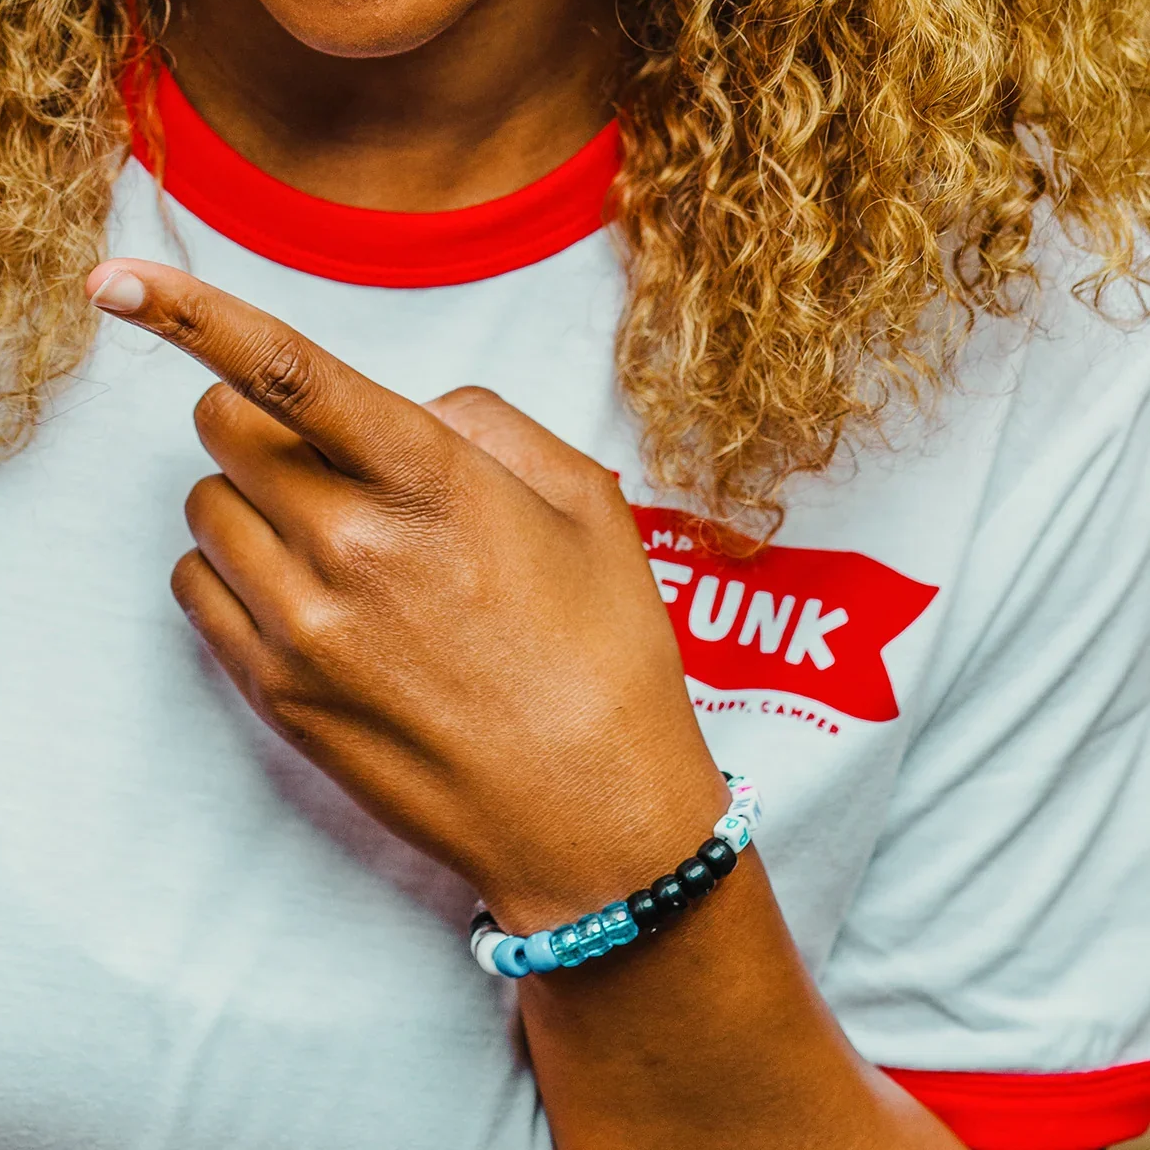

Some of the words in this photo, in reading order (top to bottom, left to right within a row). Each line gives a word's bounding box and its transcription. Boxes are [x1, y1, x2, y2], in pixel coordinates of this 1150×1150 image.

[642, 529, 694, 552] MP
[648, 558, 849, 671] FUNK
[761, 700, 840, 735] CAMPER
